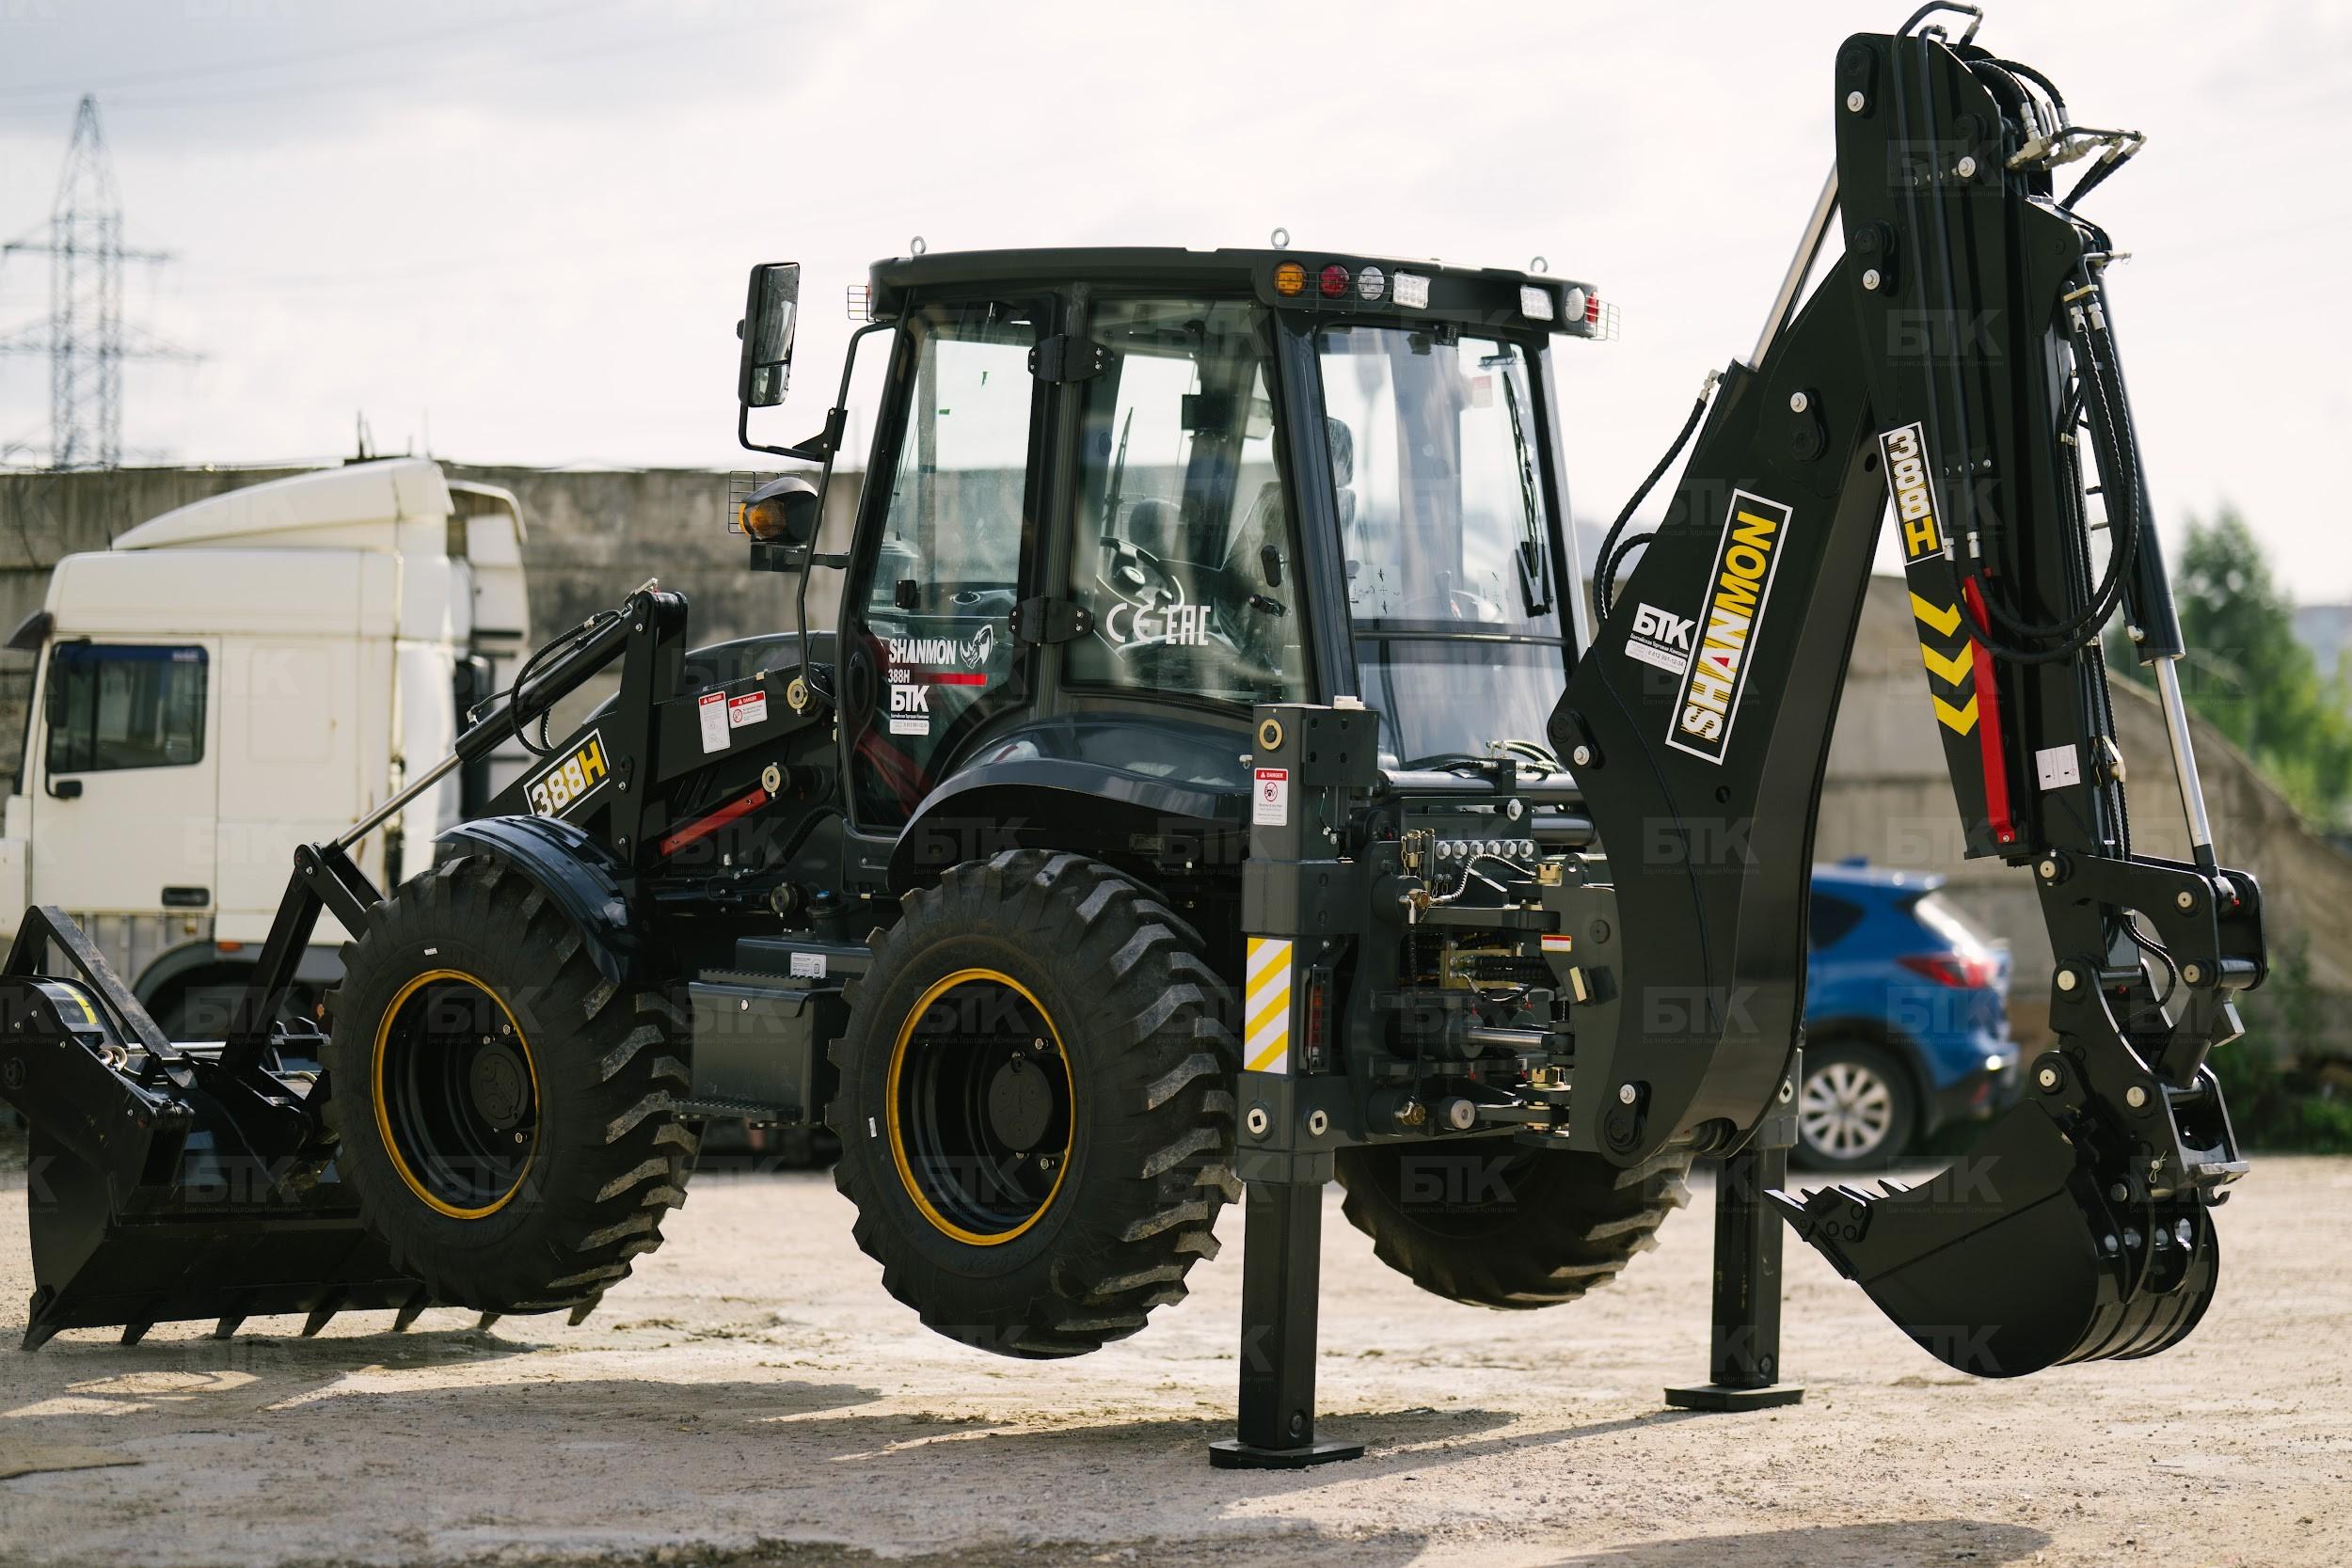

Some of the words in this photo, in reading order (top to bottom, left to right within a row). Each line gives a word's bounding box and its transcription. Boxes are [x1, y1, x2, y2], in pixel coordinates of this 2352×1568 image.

[1888, 428, 1938, 557] 388H
[1632, 602, 1695, 650] БТК
[1680, 511, 1776, 742] SHANMON
[889, 639, 957, 664] SHANMON
[888, 669, 910, 683] 388H
[891, 685, 930, 712] БТК
[532, 740, 606, 817] 388H
